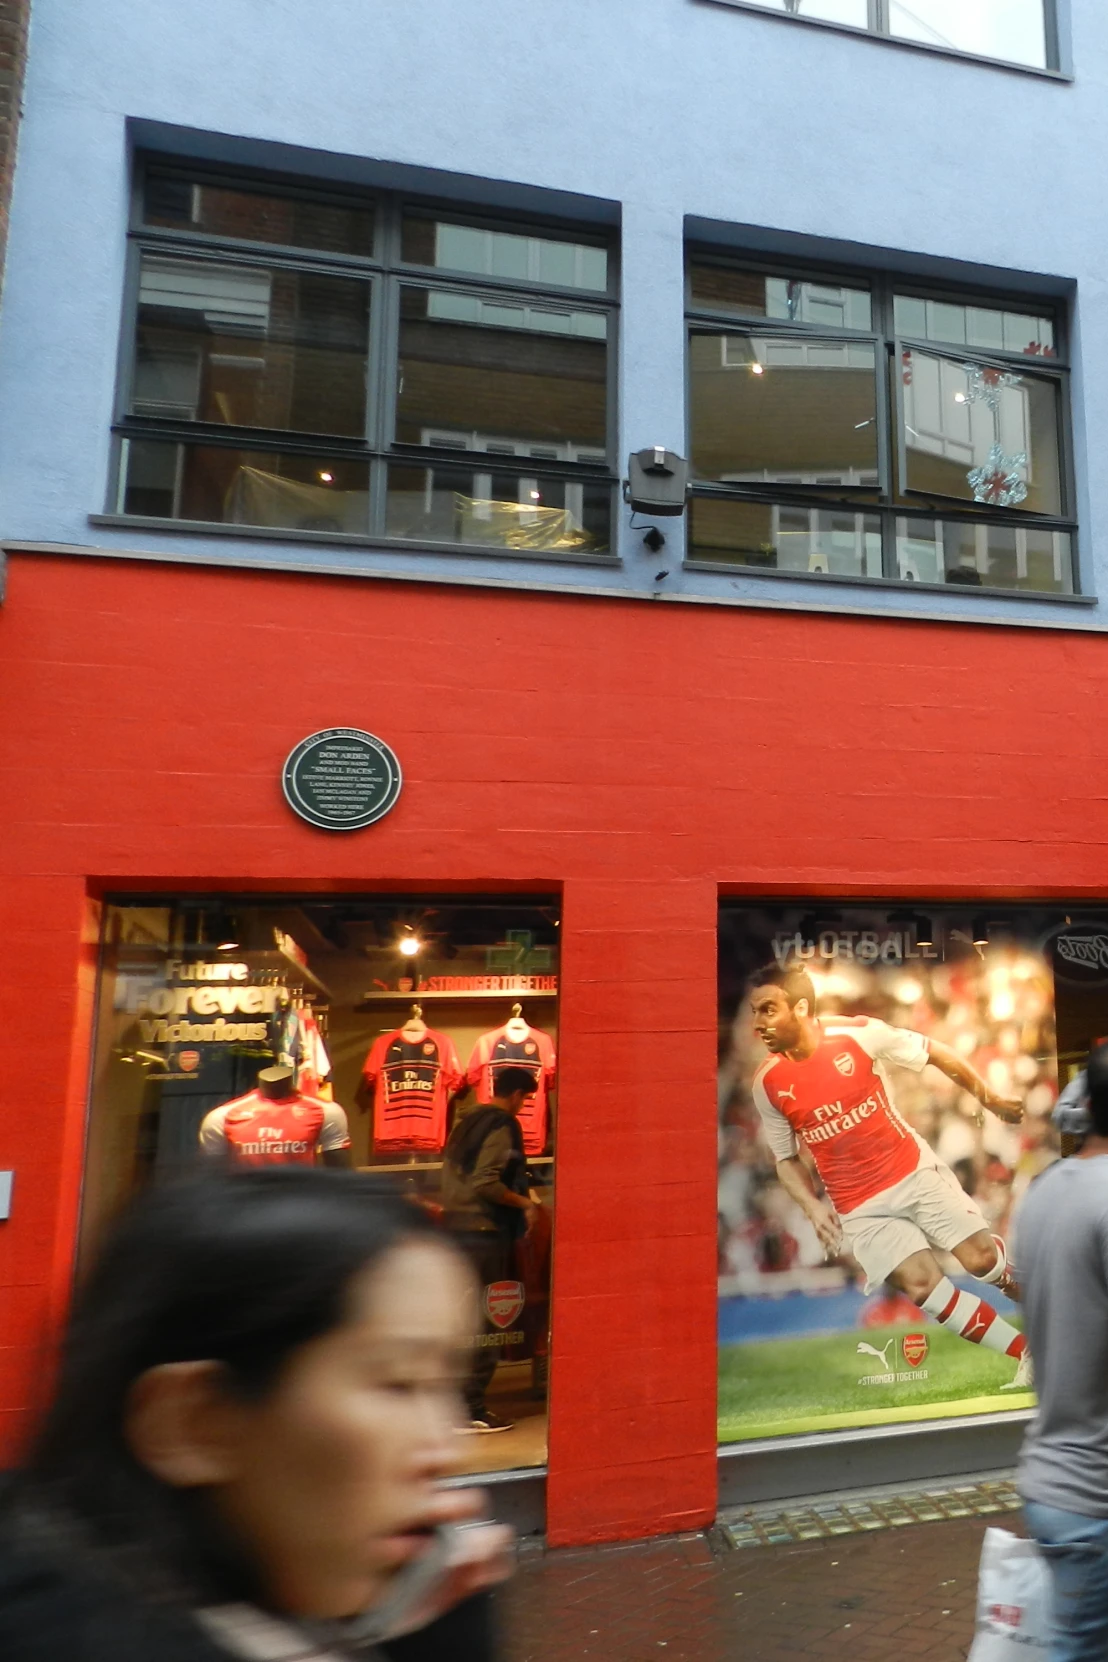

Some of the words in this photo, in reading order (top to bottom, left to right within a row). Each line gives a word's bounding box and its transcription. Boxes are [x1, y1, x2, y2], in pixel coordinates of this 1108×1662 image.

[304, 735, 322, 748] CITY
[336, 730, 385, 751] WESTMINSTER
[341, 752, 370, 760] ARDEN
[775, 931, 938, 958] FOOTBALL
[166, 959, 248, 980] Future
[126, 980, 281, 1015] Forever
[140, 1018, 267, 1042] Victorious
[404, 1070, 418, 1079] Fly
[391, 1079, 433, 1092] Emirates
[813, 1101, 843, 1122] Fly
[257, 1127, 284, 1139] Fly
[476, 1332, 524, 1347] TOGETHER
[858, 1373, 895, 1386] #STRONGER
[896, 1370, 929, 1382] TOGETHER
